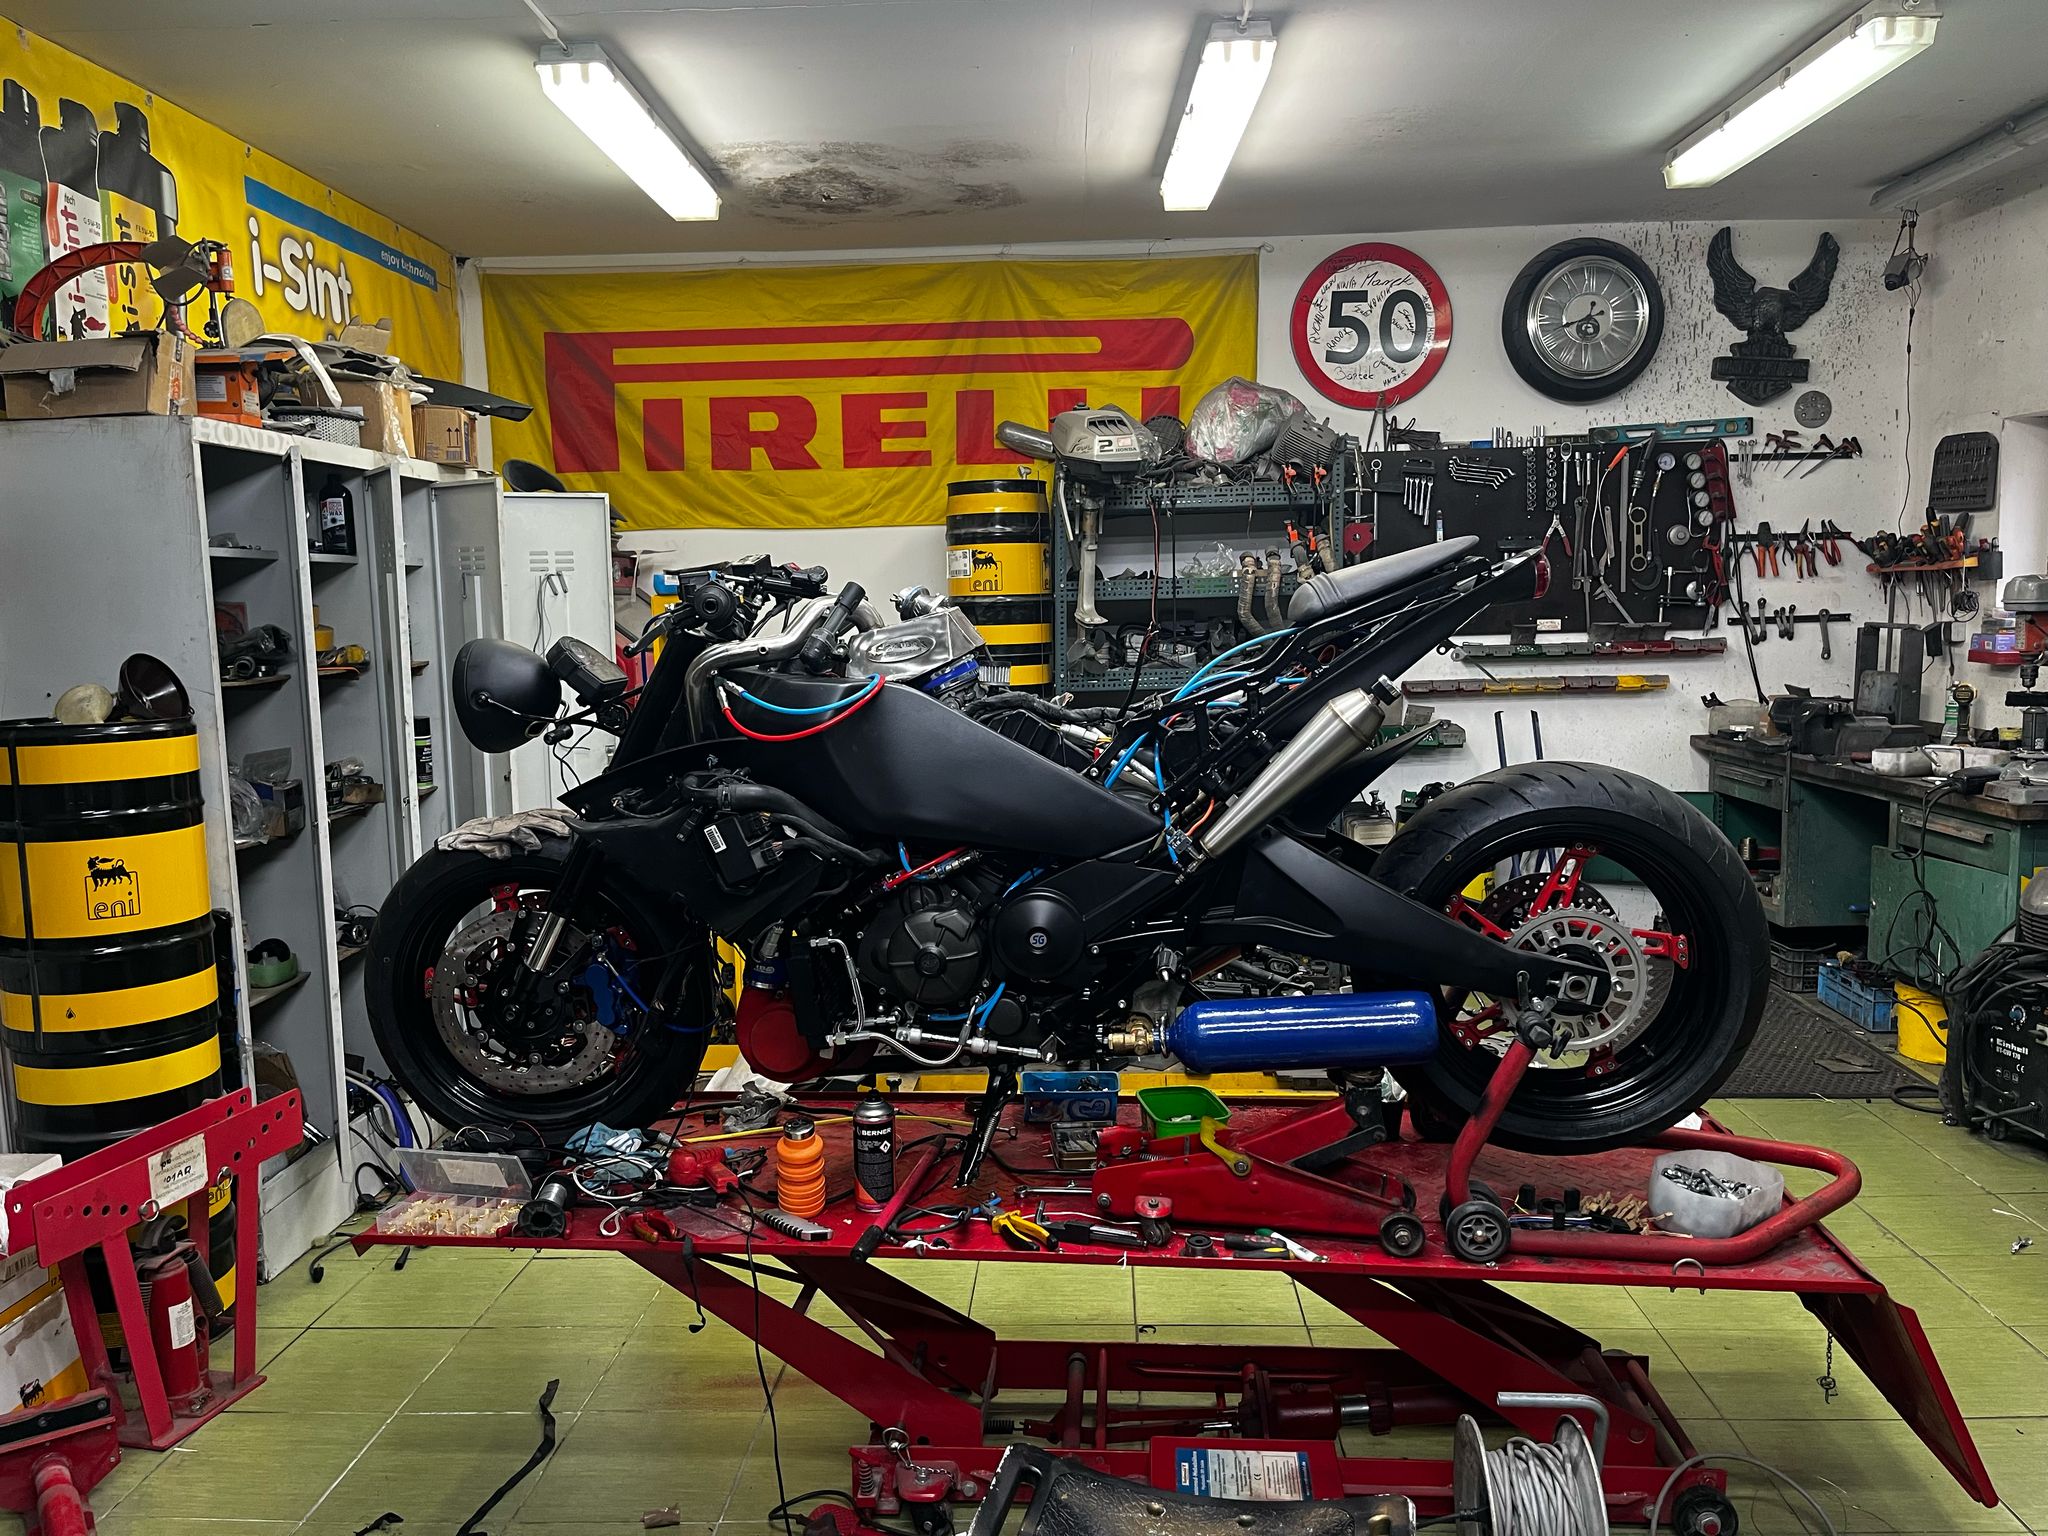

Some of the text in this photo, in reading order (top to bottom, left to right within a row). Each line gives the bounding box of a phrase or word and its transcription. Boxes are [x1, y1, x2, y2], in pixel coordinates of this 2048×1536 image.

[249, 217, 352, 326] i-Sint
[381, 250, 435, 286] enjoy technology
[1325, 289, 1428, 365] 50
[1099, 440, 1113, 453] 2
[972, 574, 999, 592] eni
[94, 891, 135, 919] eni
[1031, 935, 1045, 945] SG
[1996, 1037, 2029, 1056] Einhell
[861, 1127, 892, 1137] BERNER
